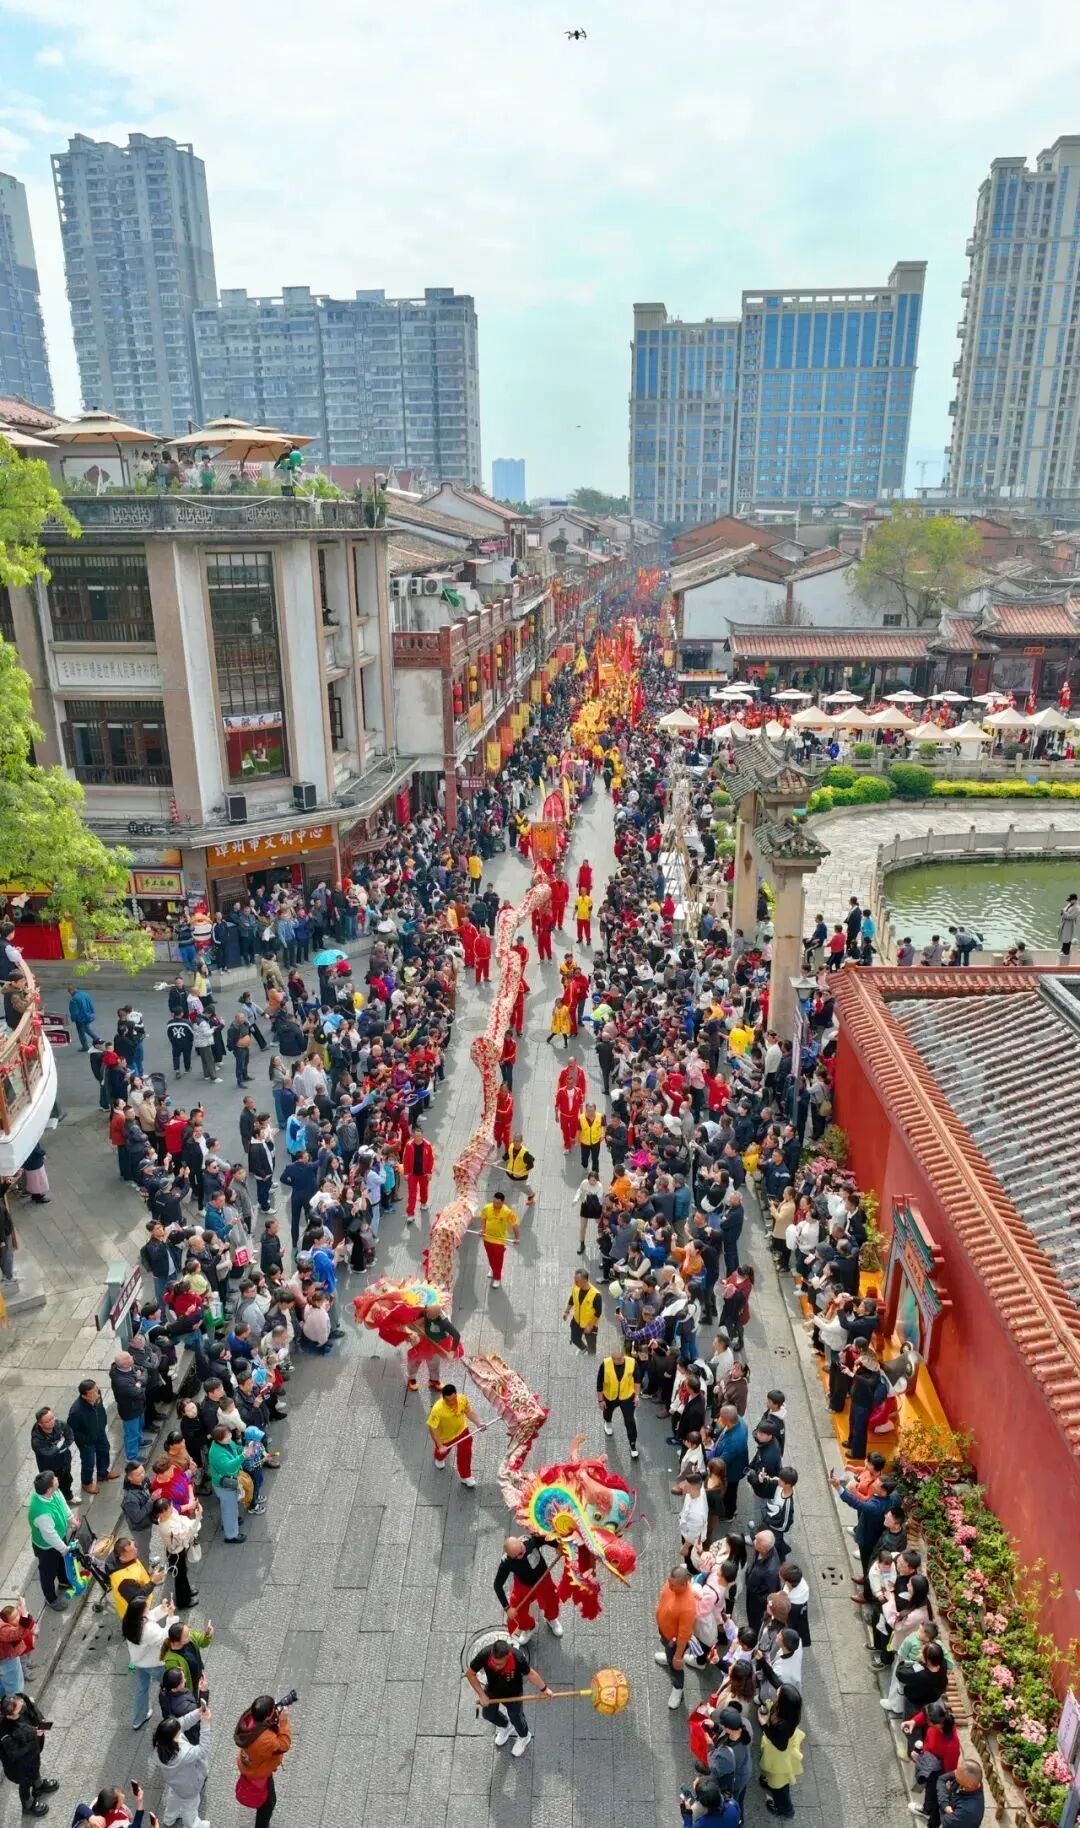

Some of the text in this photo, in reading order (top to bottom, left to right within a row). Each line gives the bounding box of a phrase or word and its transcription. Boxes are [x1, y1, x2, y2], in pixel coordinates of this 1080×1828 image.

[215, 827, 323, 857] 漳州市文创中心
[172, 1026, 186, 1039] NY
